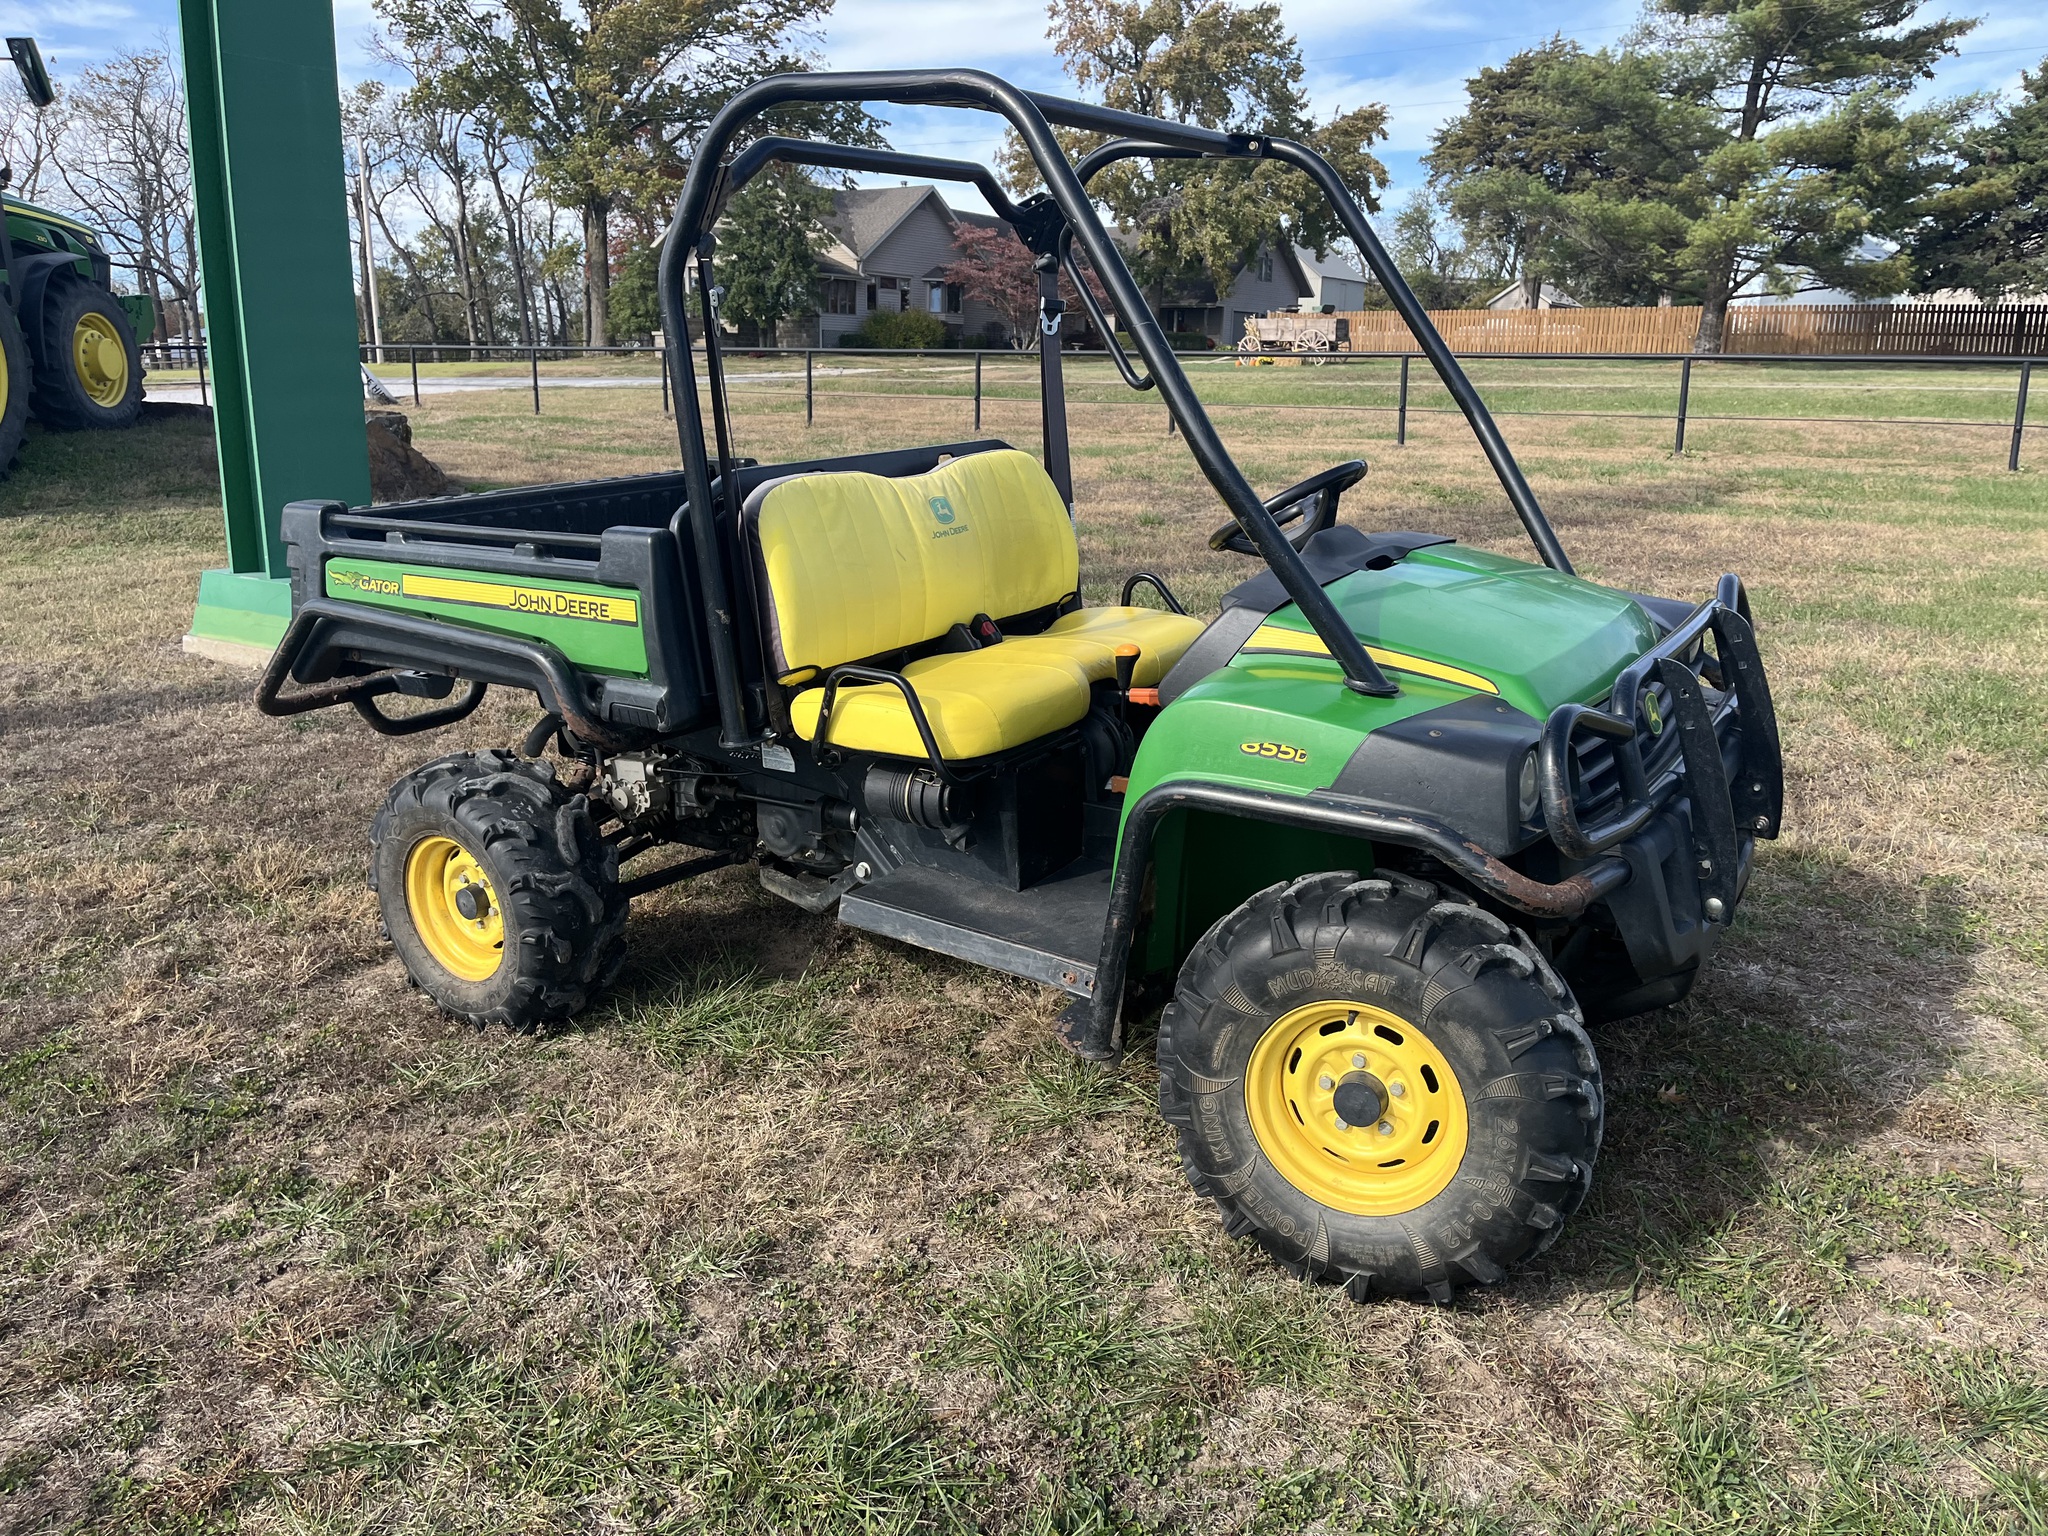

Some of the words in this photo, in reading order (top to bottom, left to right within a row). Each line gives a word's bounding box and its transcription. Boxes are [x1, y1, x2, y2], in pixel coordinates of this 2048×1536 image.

[932, 530, 950, 539] JOHN
[949, 525, 969, 535] DEERE
[358, 575, 400, 596] GATOR
[509, 589, 552, 613] JOHN
[555, 594, 610, 619] DEERE
[1267, 968, 1315, 999] MUD
[1350, 968, 1397, 996] CAT
[1200, 1096, 1234, 1163] KING
[1225, 1169, 1313, 1248] POWER
